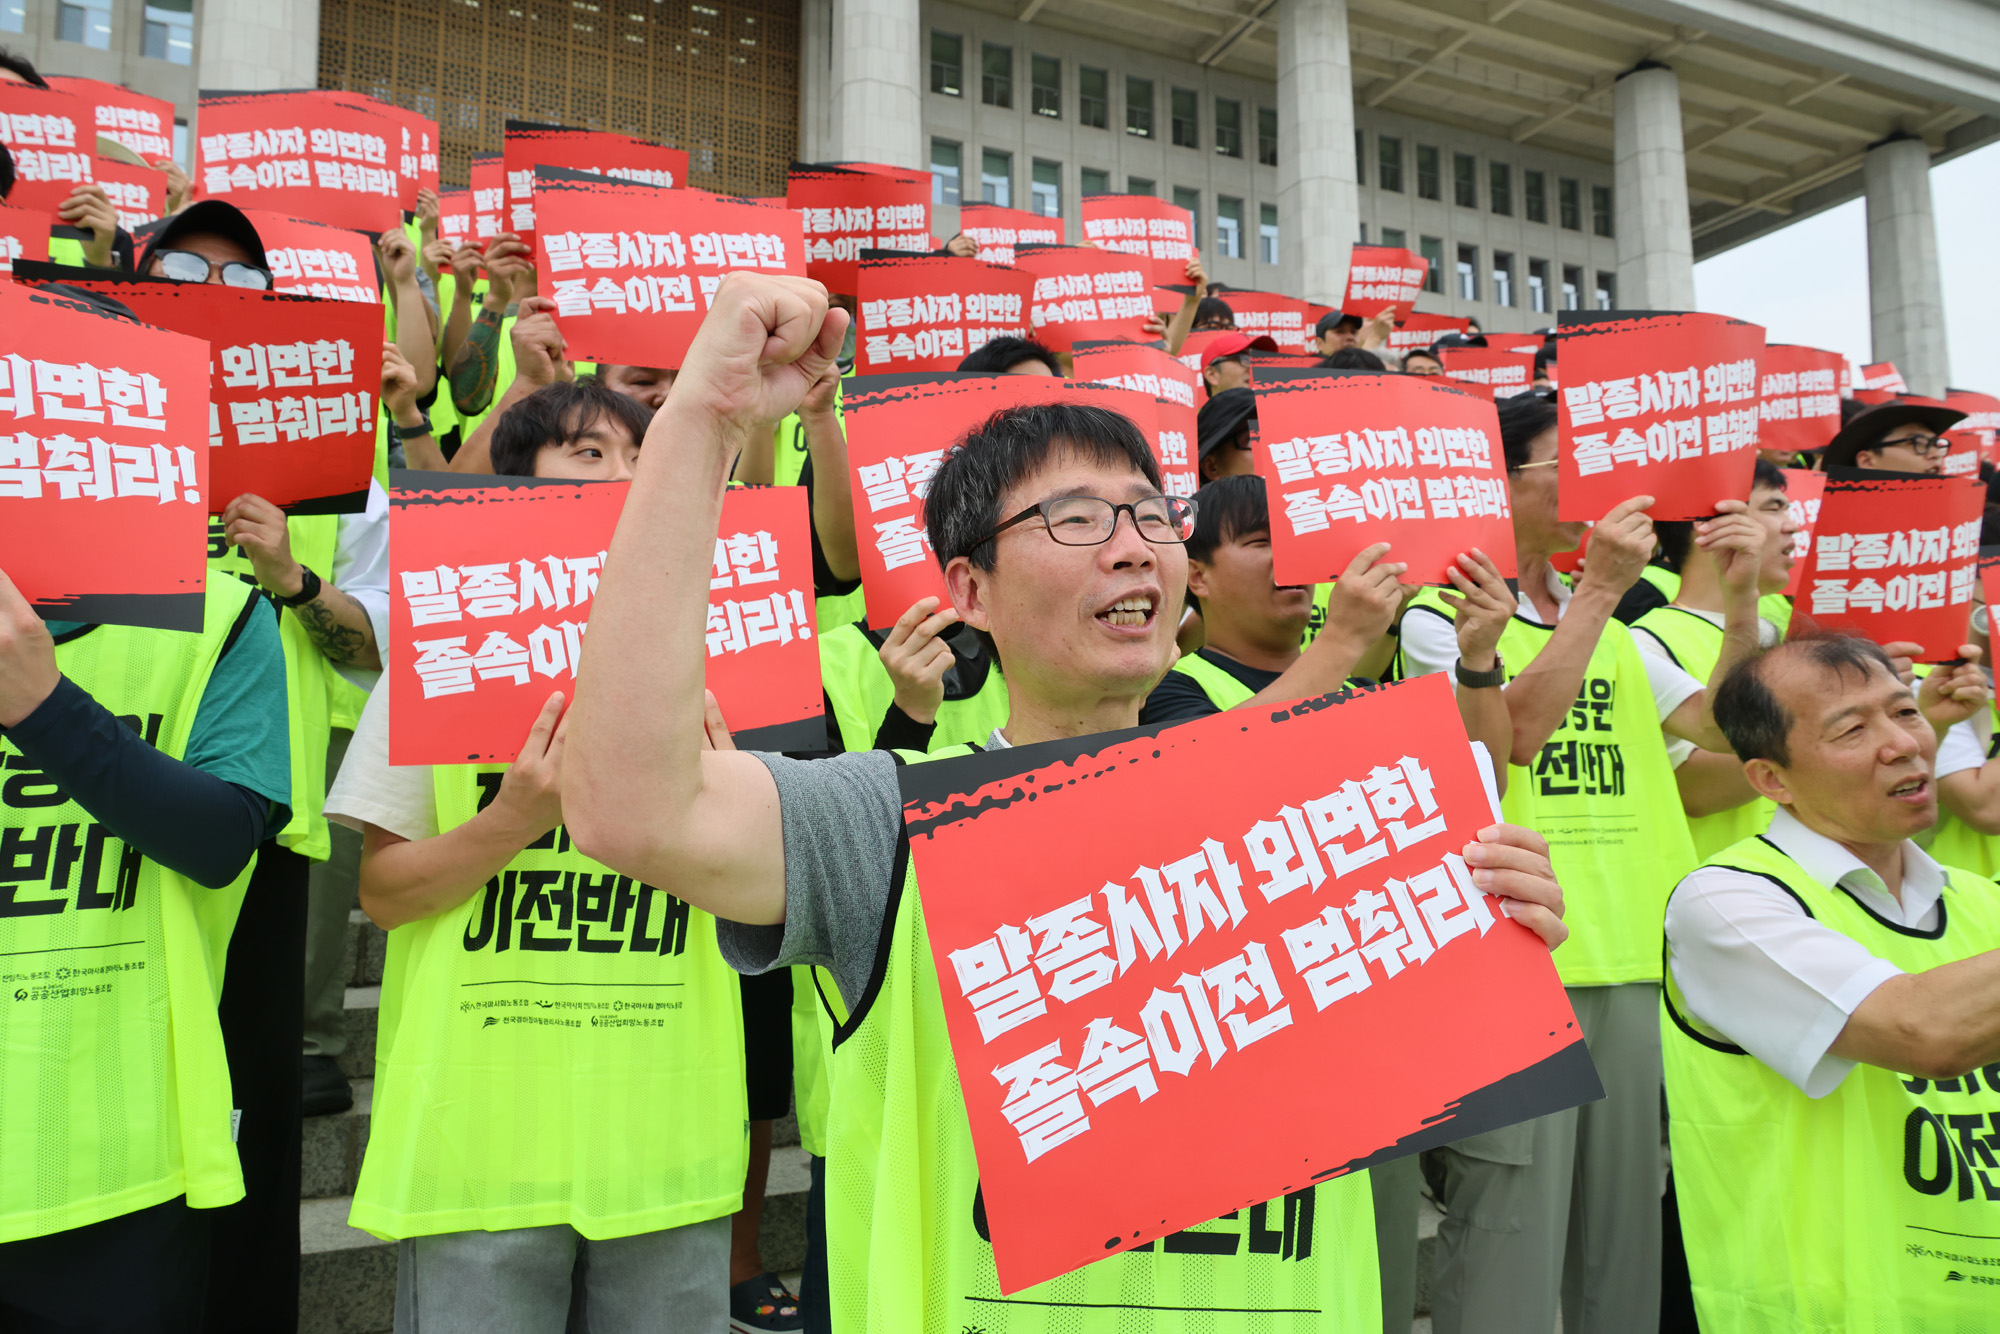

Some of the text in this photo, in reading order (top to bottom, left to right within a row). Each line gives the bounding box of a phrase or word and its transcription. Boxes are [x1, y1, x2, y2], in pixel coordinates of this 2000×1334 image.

[8, 147, 96, 186] 춰라!
[201, 127, 308, 165] 말종사자
[310, 128, 386, 166] 외면한
[204, 156, 398, 197] 졸속이전 멈춰라!
[877, 204, 925, 230] 외면한
[1148, 219, 1187, 242] 외면한
[265, 247, 359, 280] 외면한
[543, 231, 786, 272] 말종사자 외면한
[550, 274, 695, 317] 졸속이전
[1094, 271, 1144, 294] 외면한
[862, 293, 1022, 333] 말종사자 외면한
[1097, 294, 1156, 321] 멈춰라!
[221, 339, 354, 390] 외면한
[866, 326, 964, 364] 졸속이전
[1564, 359, 1756, 430] 말종사자 외면한
[1797, 369, 1834, 391] 외면한
[230, 391, 372, 445] 멈춰라!
[1268, 426, 1492, 486] 말종사자 외면한
[1571, 406, 1759, 476] 졸속이전 멈춰라!
[1281, 474, 1510, 536] 졸속이전 멈춰라!
[1817, 526, 1950, 571] 말종사자
[1812, 571, 1946, 614] 졸속이전
[706, 588, 812, 658] 춰라!
[413, 619, 587, 700] 졸속이
[463, 870, 691, 957] 이전반대
[946, 754, 1449, 1046] 말종사자 외면한
[989, 940, 1295, 1165] 졸속이전
